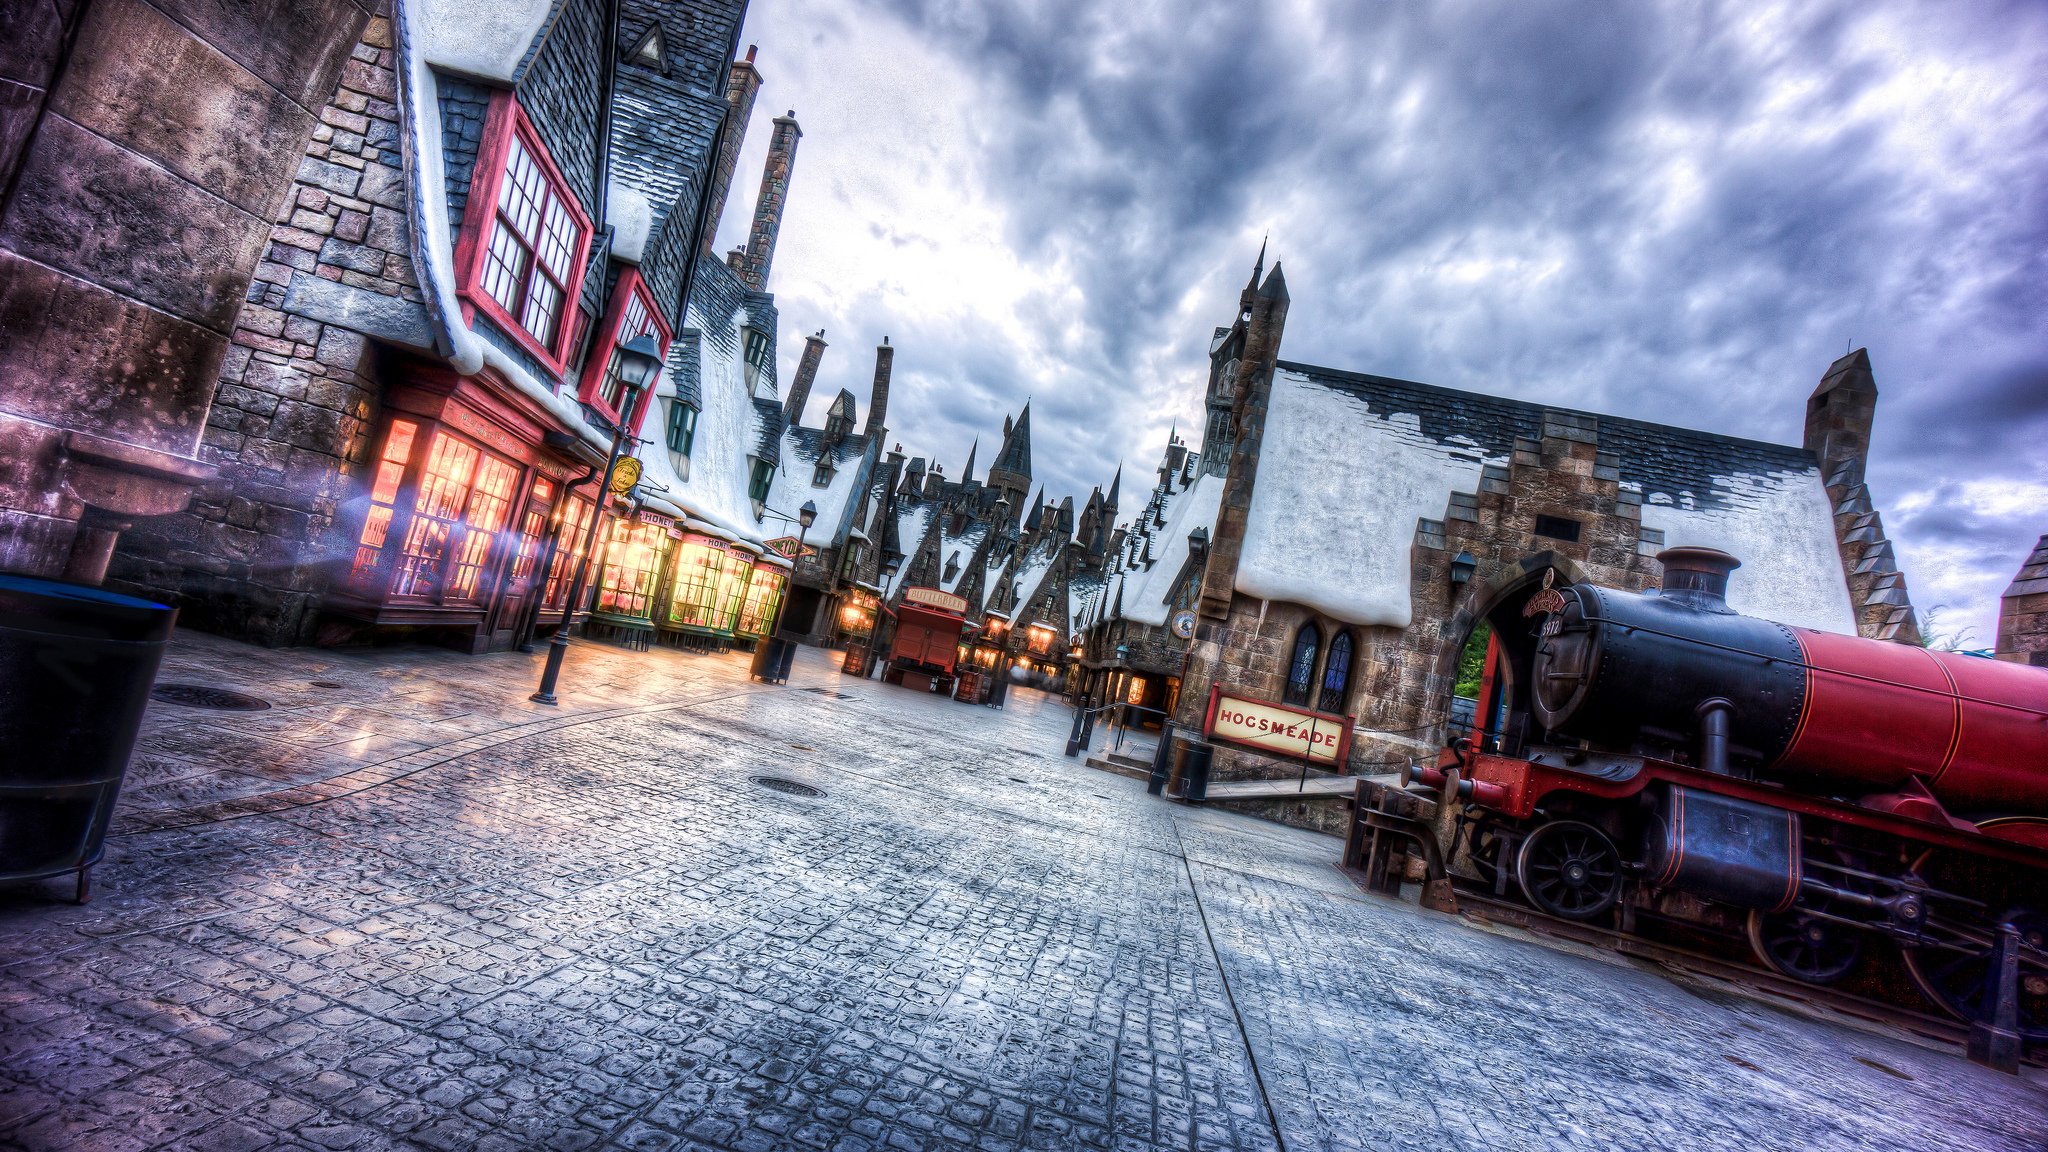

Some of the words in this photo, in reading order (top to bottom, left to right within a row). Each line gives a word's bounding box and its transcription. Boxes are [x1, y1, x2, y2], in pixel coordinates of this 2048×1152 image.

[911, 590, 963, 610] BUTTERBEER
[1542, 620, 1560, 636] 5972
[1220, 709, 1337, 747] HOGSMEADE
